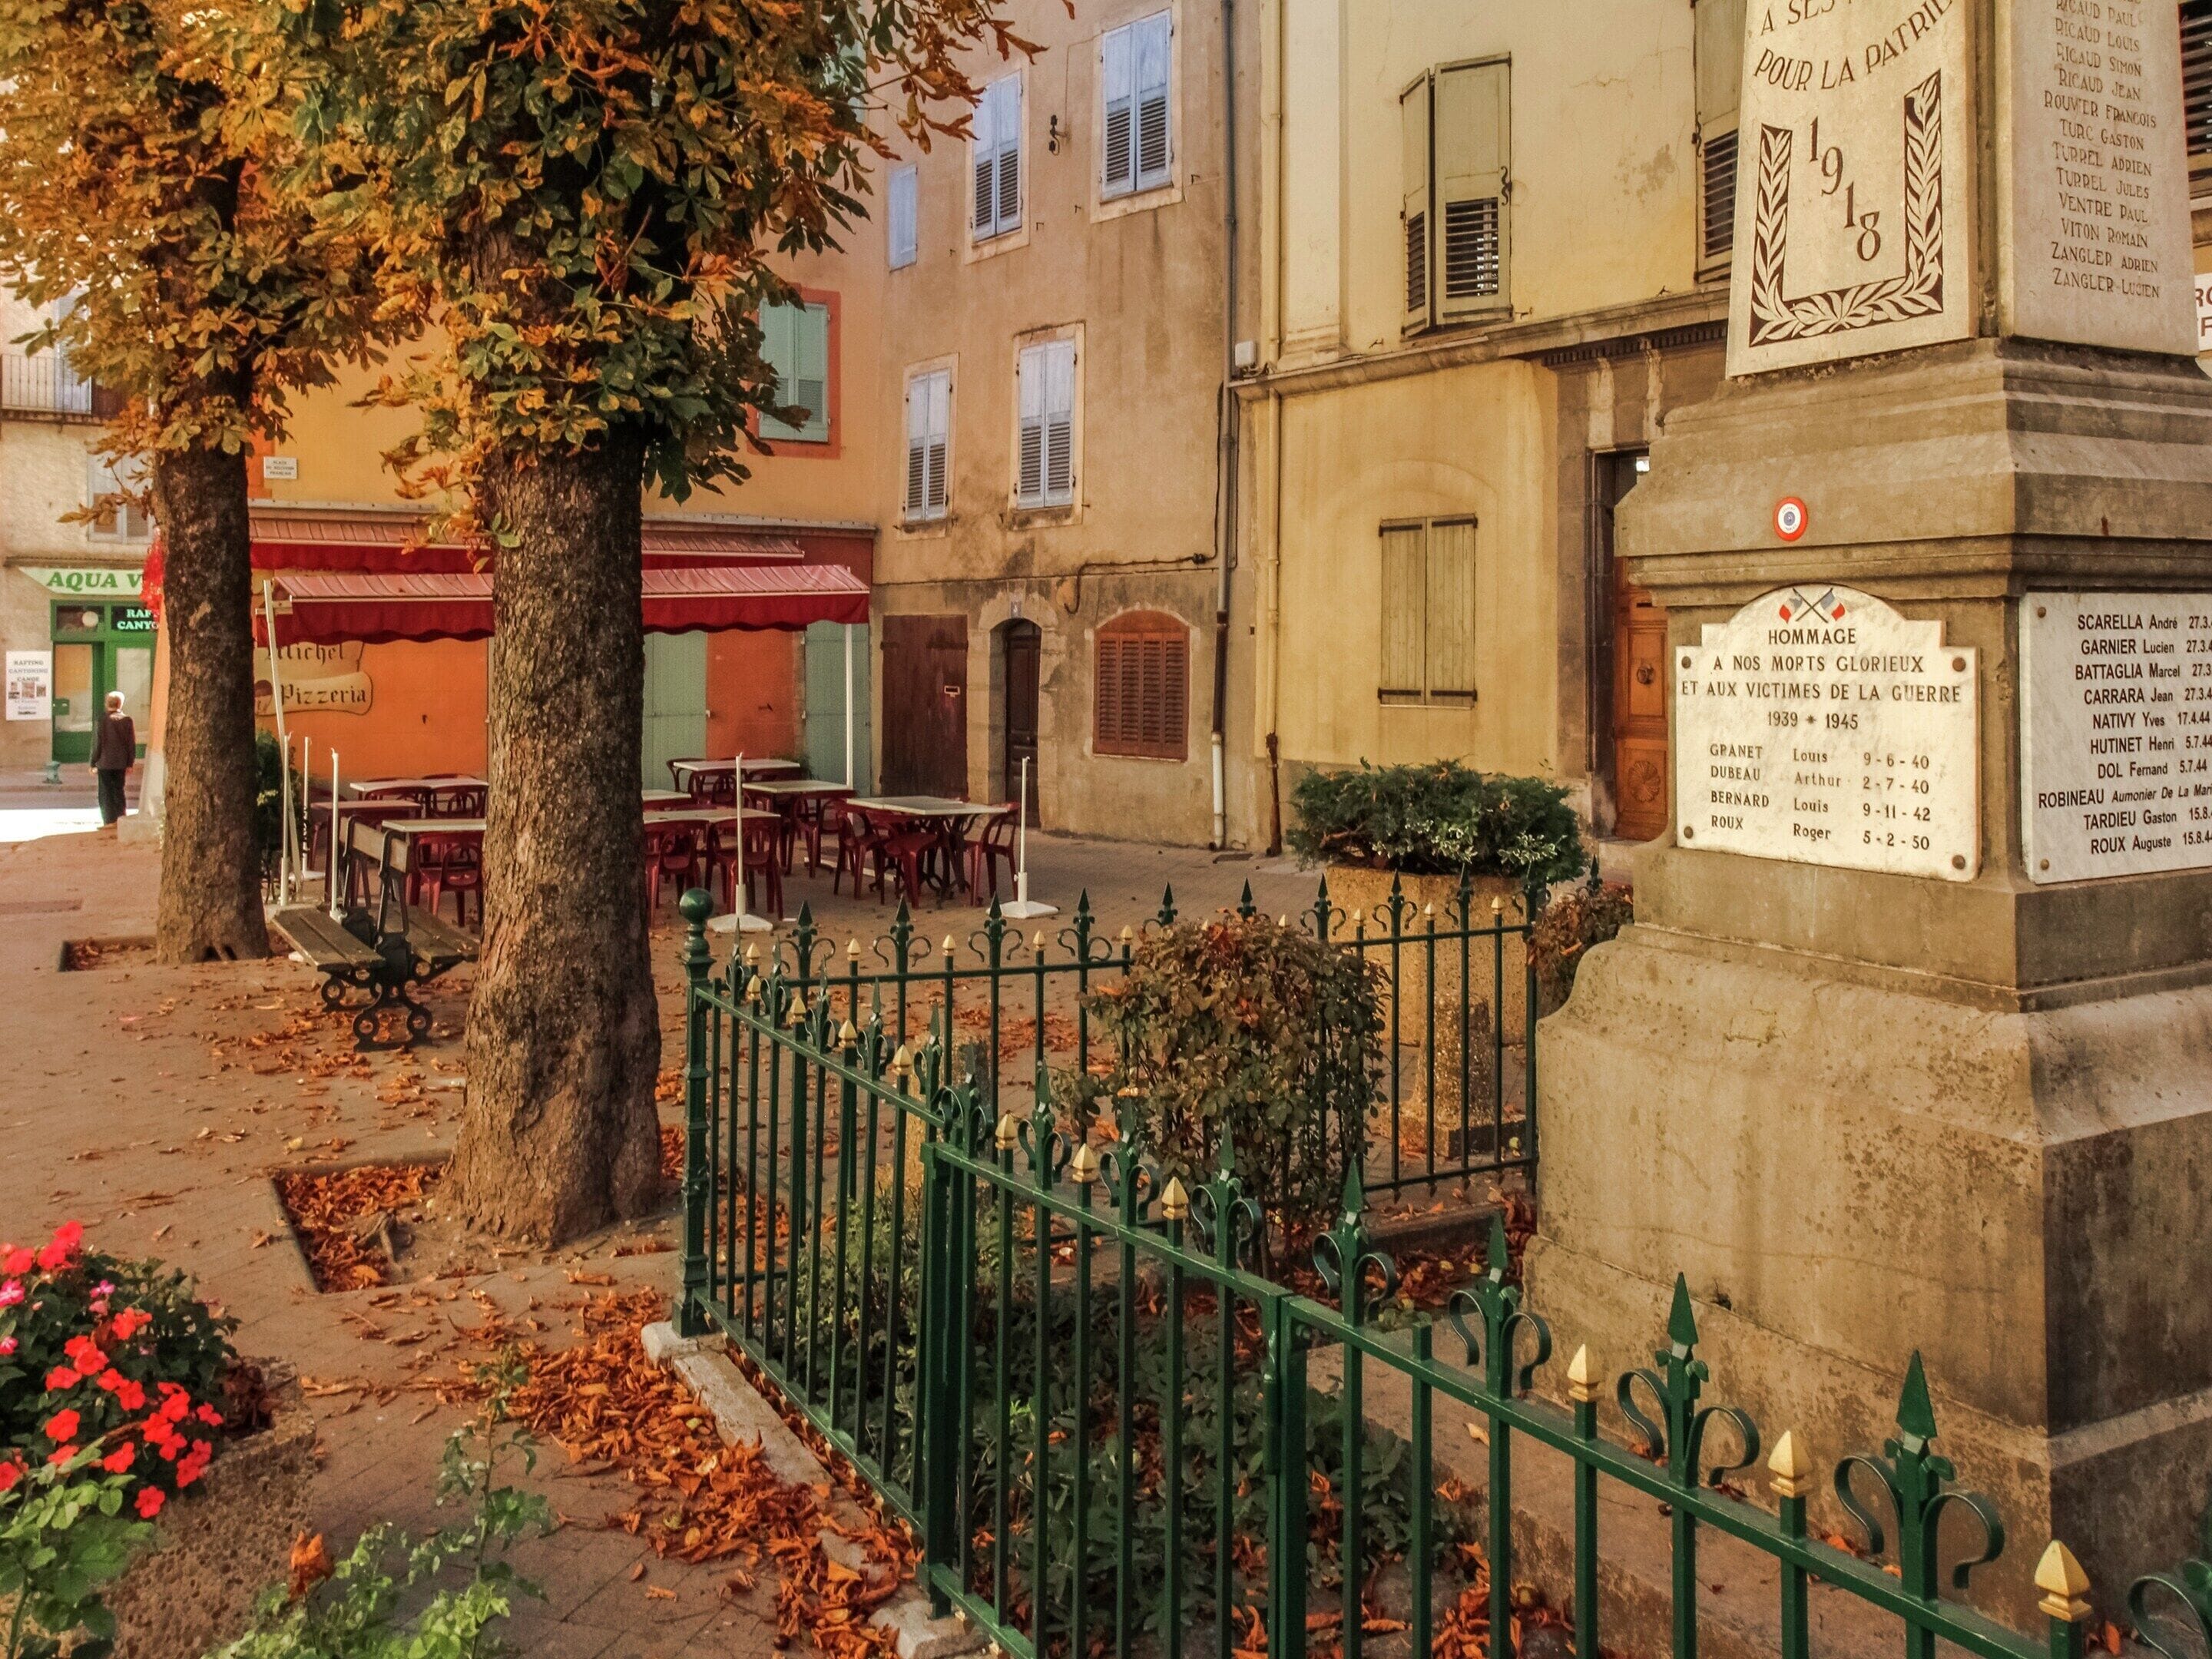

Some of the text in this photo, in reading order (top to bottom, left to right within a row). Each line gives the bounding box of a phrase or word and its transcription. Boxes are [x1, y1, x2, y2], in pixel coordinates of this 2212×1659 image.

[1760, 8, 1775, 36] A
[2056, 0, 2137, 28] RICAUD PAUL
[1753, 0, 1952, 91] POUR LA PATRIE
[2055, 18, 2140, 52] RICAUD LOUIS
[2056, 42, 2141, 77] RICAUD SIMON
[2058, 68, 2141, 101] RICAUD JEAN
[2060, 118, 2144, 151] TURC GASTON
[2052, 141, 2152, 177] TURREL ADRIEN
[1810, 116, 1881, 261] 1918
[2056, 167, 2149, 200] TURREL JULES
[2058, 192, 2148, 223] VENTRE PAUL
[2061, 217, 2148, 248] VITON ROMAIN
[2051, 241, 2158, 273] ZANGLER ADRIEN
[2052, 267, 2160, 298] ZANGLER LUCIEN
[46, 571, 118, 592] AQUA
[2078, 614, 2143, 630] SCARELLA
[2149, 614, 2177, 630] André
[1768, 628, 1856, 645] HOMMAGE
[2081, 639, 2136, 655] GARNIER
[2144, 639, 2174, 654] Lucien
[1714, 656, 1924, 673] A NOS MORTS GLORIEUX
[2075, 664, 2143, 680] BATTAGLIA
[2149, 663, 2181, 678] Marcel
[280, 684, 366, 707] Pizzeria
[1681, 680, 1961, 703] ET AUX VICTIMES DE LA GUERRE
[2084, 687, 2145, 705] CARRARA
[2151, 687, 2173, 702] Jean
[1768, 711, 1859, 730] 1939 1945
[2093, 711, 2210, 730] NATIVY Yves 17.4.44
[1710, 743, 1763, 759] GRANET
[1793, 748, 1827, 763] Louis
[2091, 737, 2142, 754] HUTINET
[2149, 736, 2174, 751] Henri
[1710, 766, 1760, 781] DUBEAU
[1794, 772, 1841, 787] Arthur
[2098, 759, 2207, 779] DOL Fernand 5.7.44
[1710, 791, 1770, 807] BERNARD
[1793, 798, 1829, 813] Louis
[2038, 789, 2104, 809] ROBINEAU
[2111, 789, 2156, 803] Aumonier
[2161, 786, 2173, 799] De
[2178, 786, 2189, 797] La
[1711, 815, 1743, 830] ROUX
[1793, 823, 1831, 842] Roger
[2084, 811, 2136, 830] TARDIEU
[2144, 810, 2177, 825] Gaston
[2091, 836, 2125, 854] ROUX
[2132, 835, 2171, 852] Auguste
